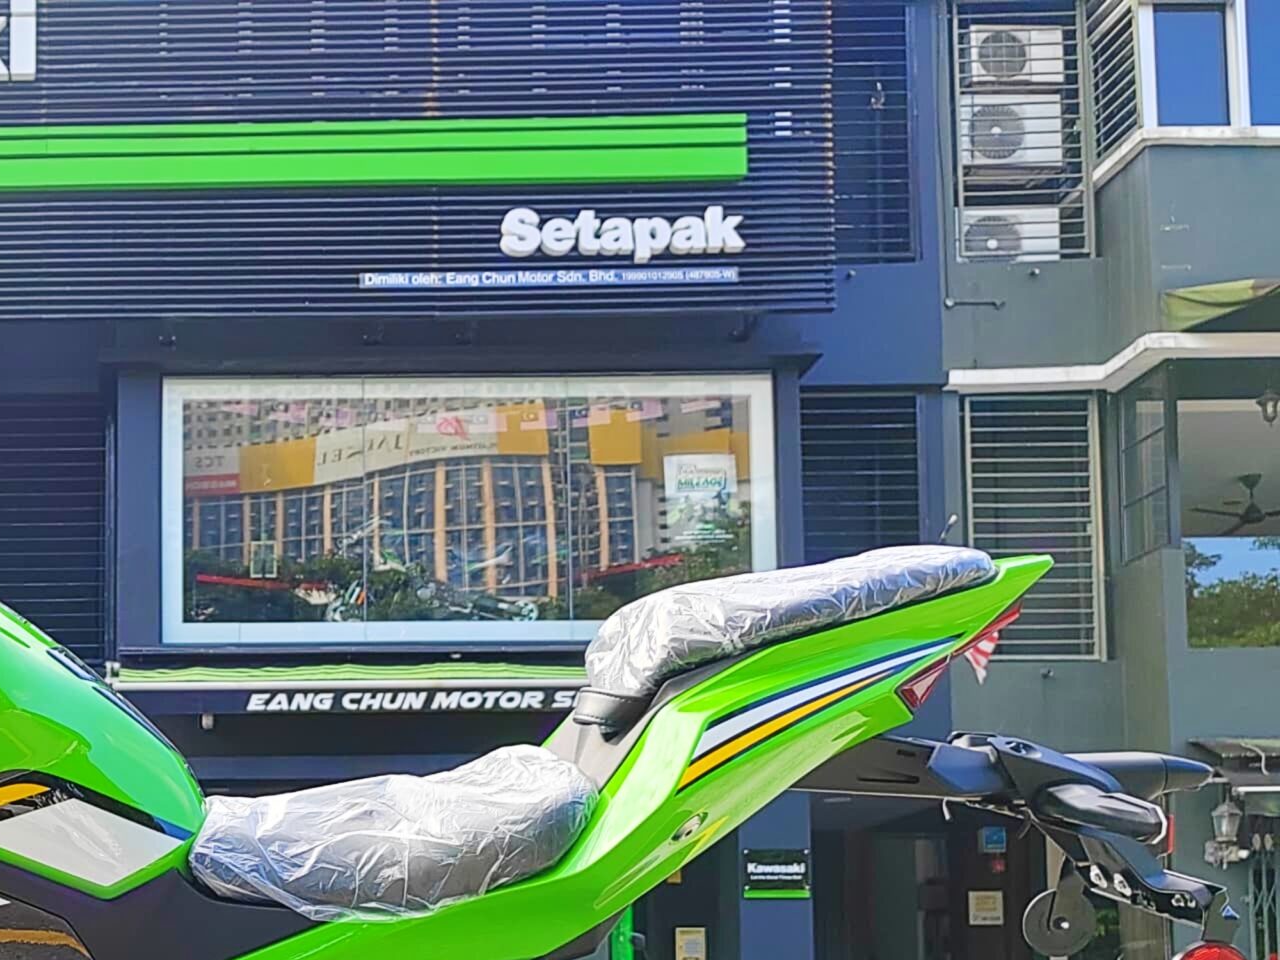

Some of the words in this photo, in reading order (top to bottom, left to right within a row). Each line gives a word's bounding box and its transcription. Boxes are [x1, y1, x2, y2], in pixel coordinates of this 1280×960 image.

[500, 205, 747, 263] Setapak
[364, 273, 409, 286] Dimiliki
[412, 272, 442, 285] oleh:
[446, 272, 479, 287] Eang
[482, 271, 516, 284] Chun
[518, 271, 554, 283] Motor
[557, 270, 585, 282] Sdn.
[590, 269, 617, 282] Bhd.
[246, 692, 334, 712] EANG
[341, 691, 429, 711] CHUN
[431, 690, 549, 711] MOTOR
[747, 862, 806, 874] Kawasaki
